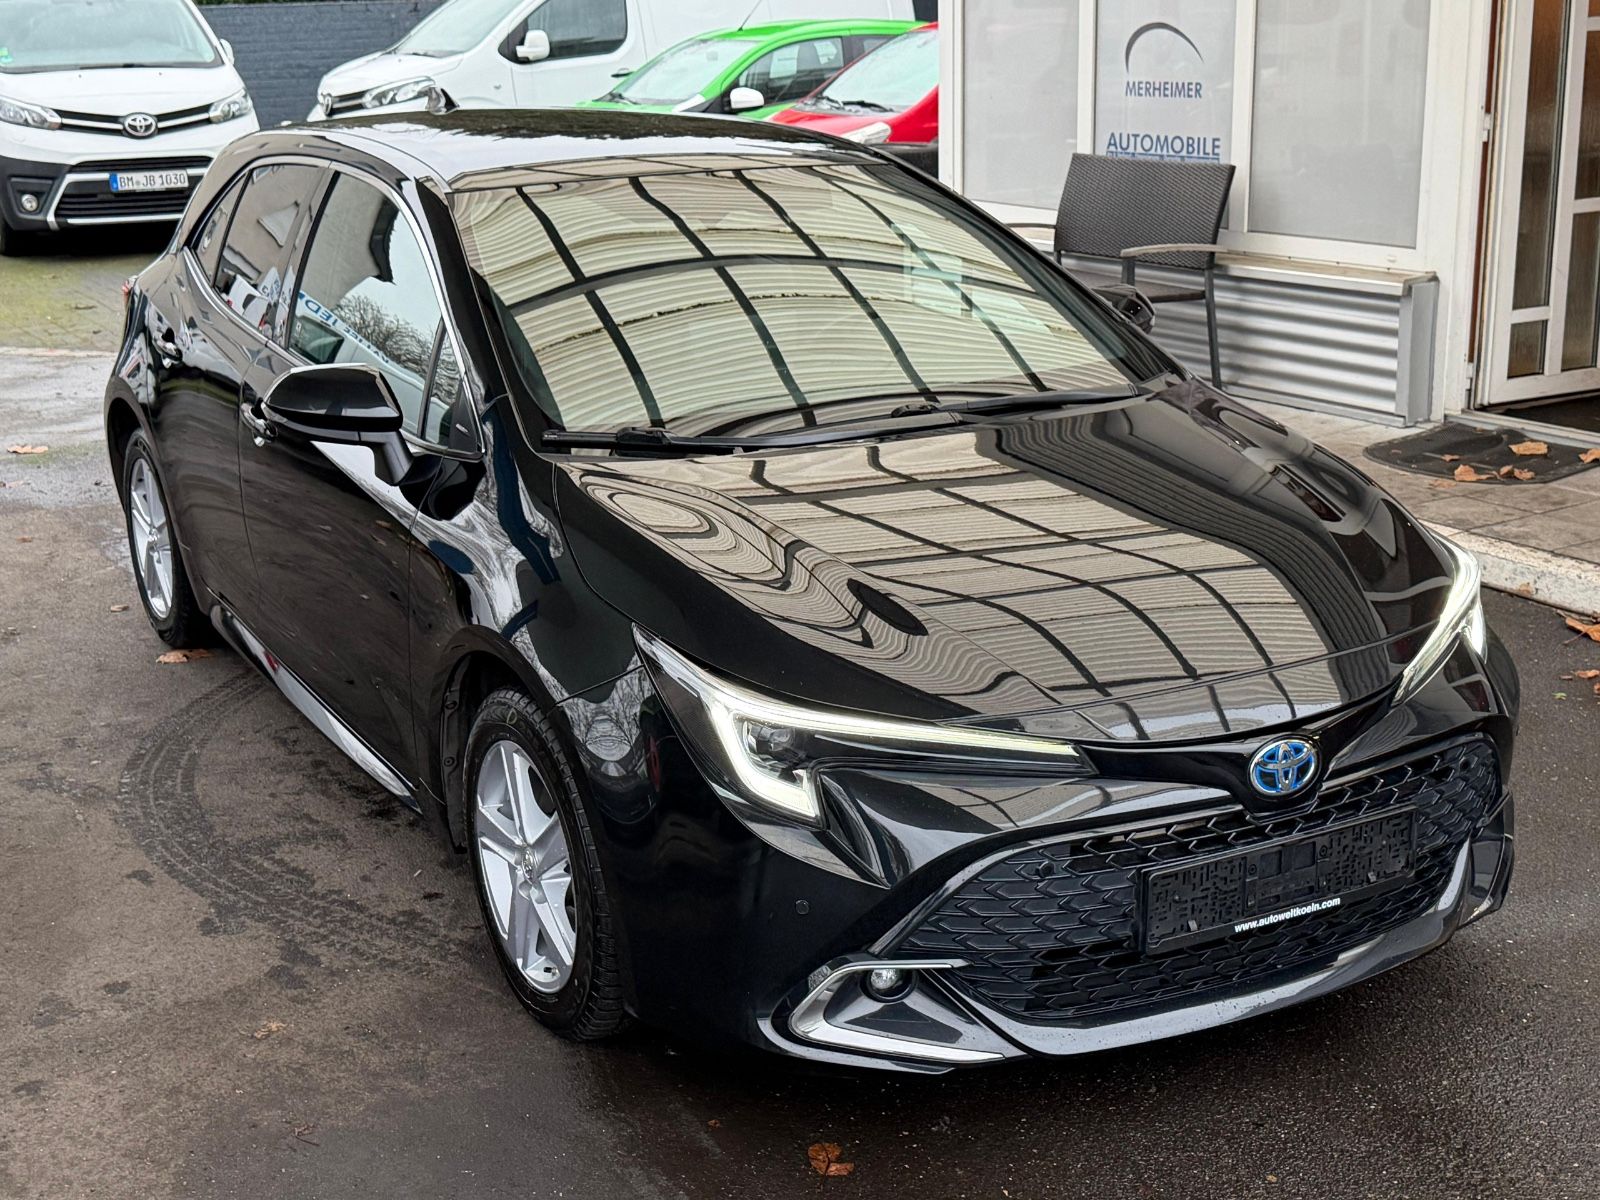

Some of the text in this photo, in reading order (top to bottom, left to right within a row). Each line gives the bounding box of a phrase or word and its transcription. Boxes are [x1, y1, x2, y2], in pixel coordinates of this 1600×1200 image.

[1125, 80, 1202, 99] MERHEIMER
[1106, 132, 1221, 157] AUTOMOBILE
[119, 173, 186, 188] BM JB 1030
[1234, 897, 1341, 933] www.autoweltkoeln.com
